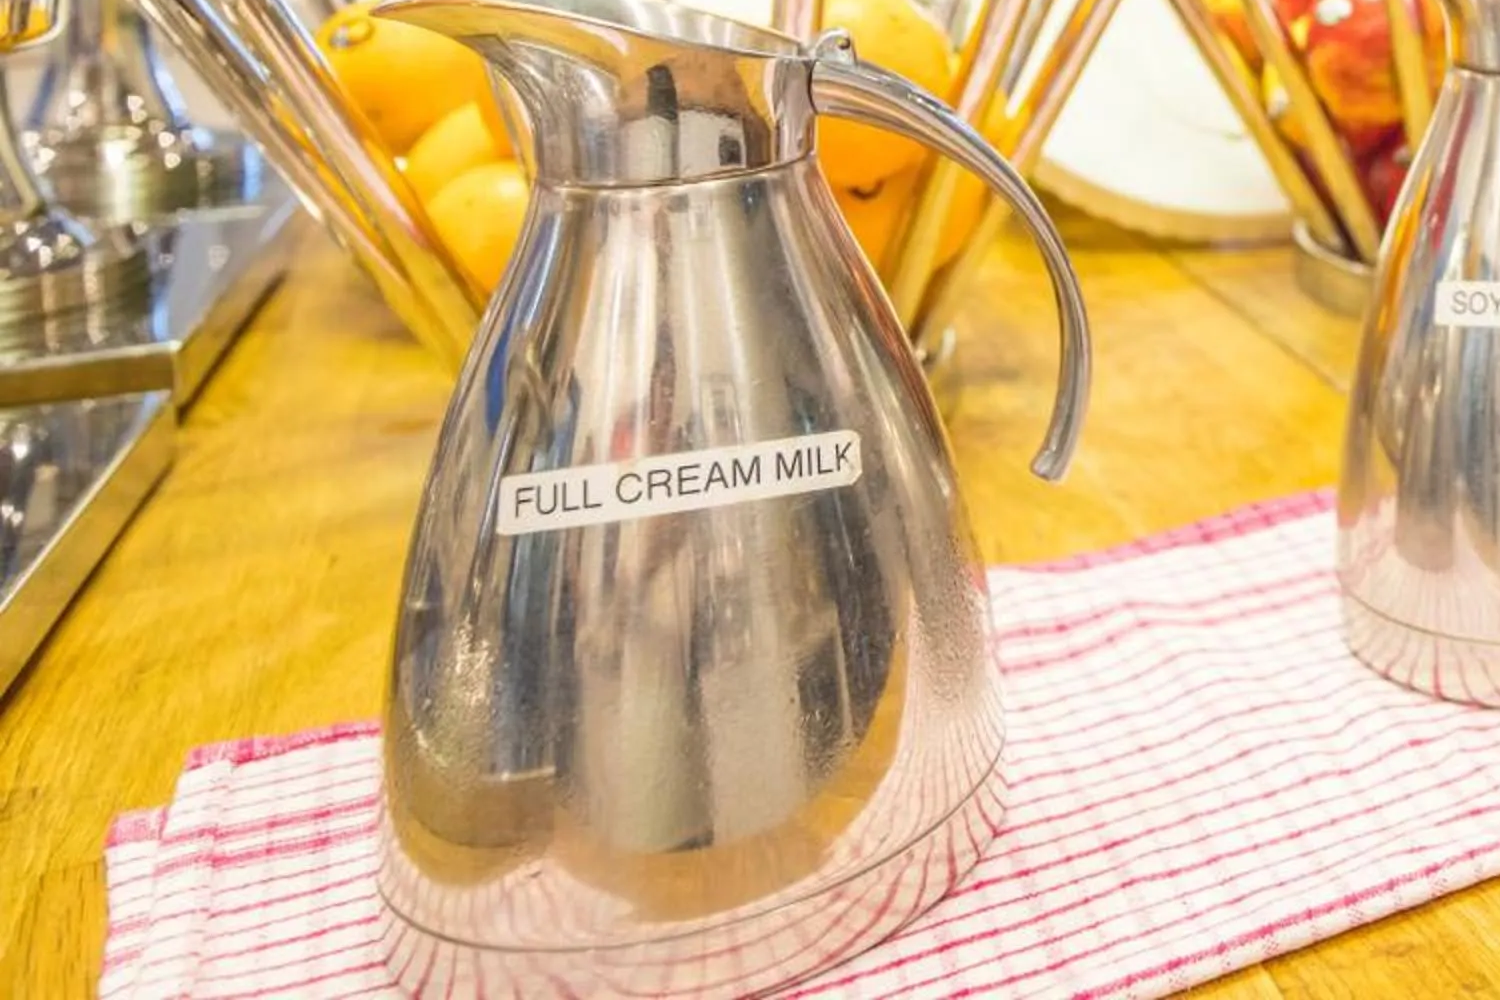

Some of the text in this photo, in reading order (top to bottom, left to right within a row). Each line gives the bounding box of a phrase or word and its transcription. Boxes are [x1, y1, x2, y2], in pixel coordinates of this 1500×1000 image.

[515, 442, 853, 518] FULL CREAM MILK
